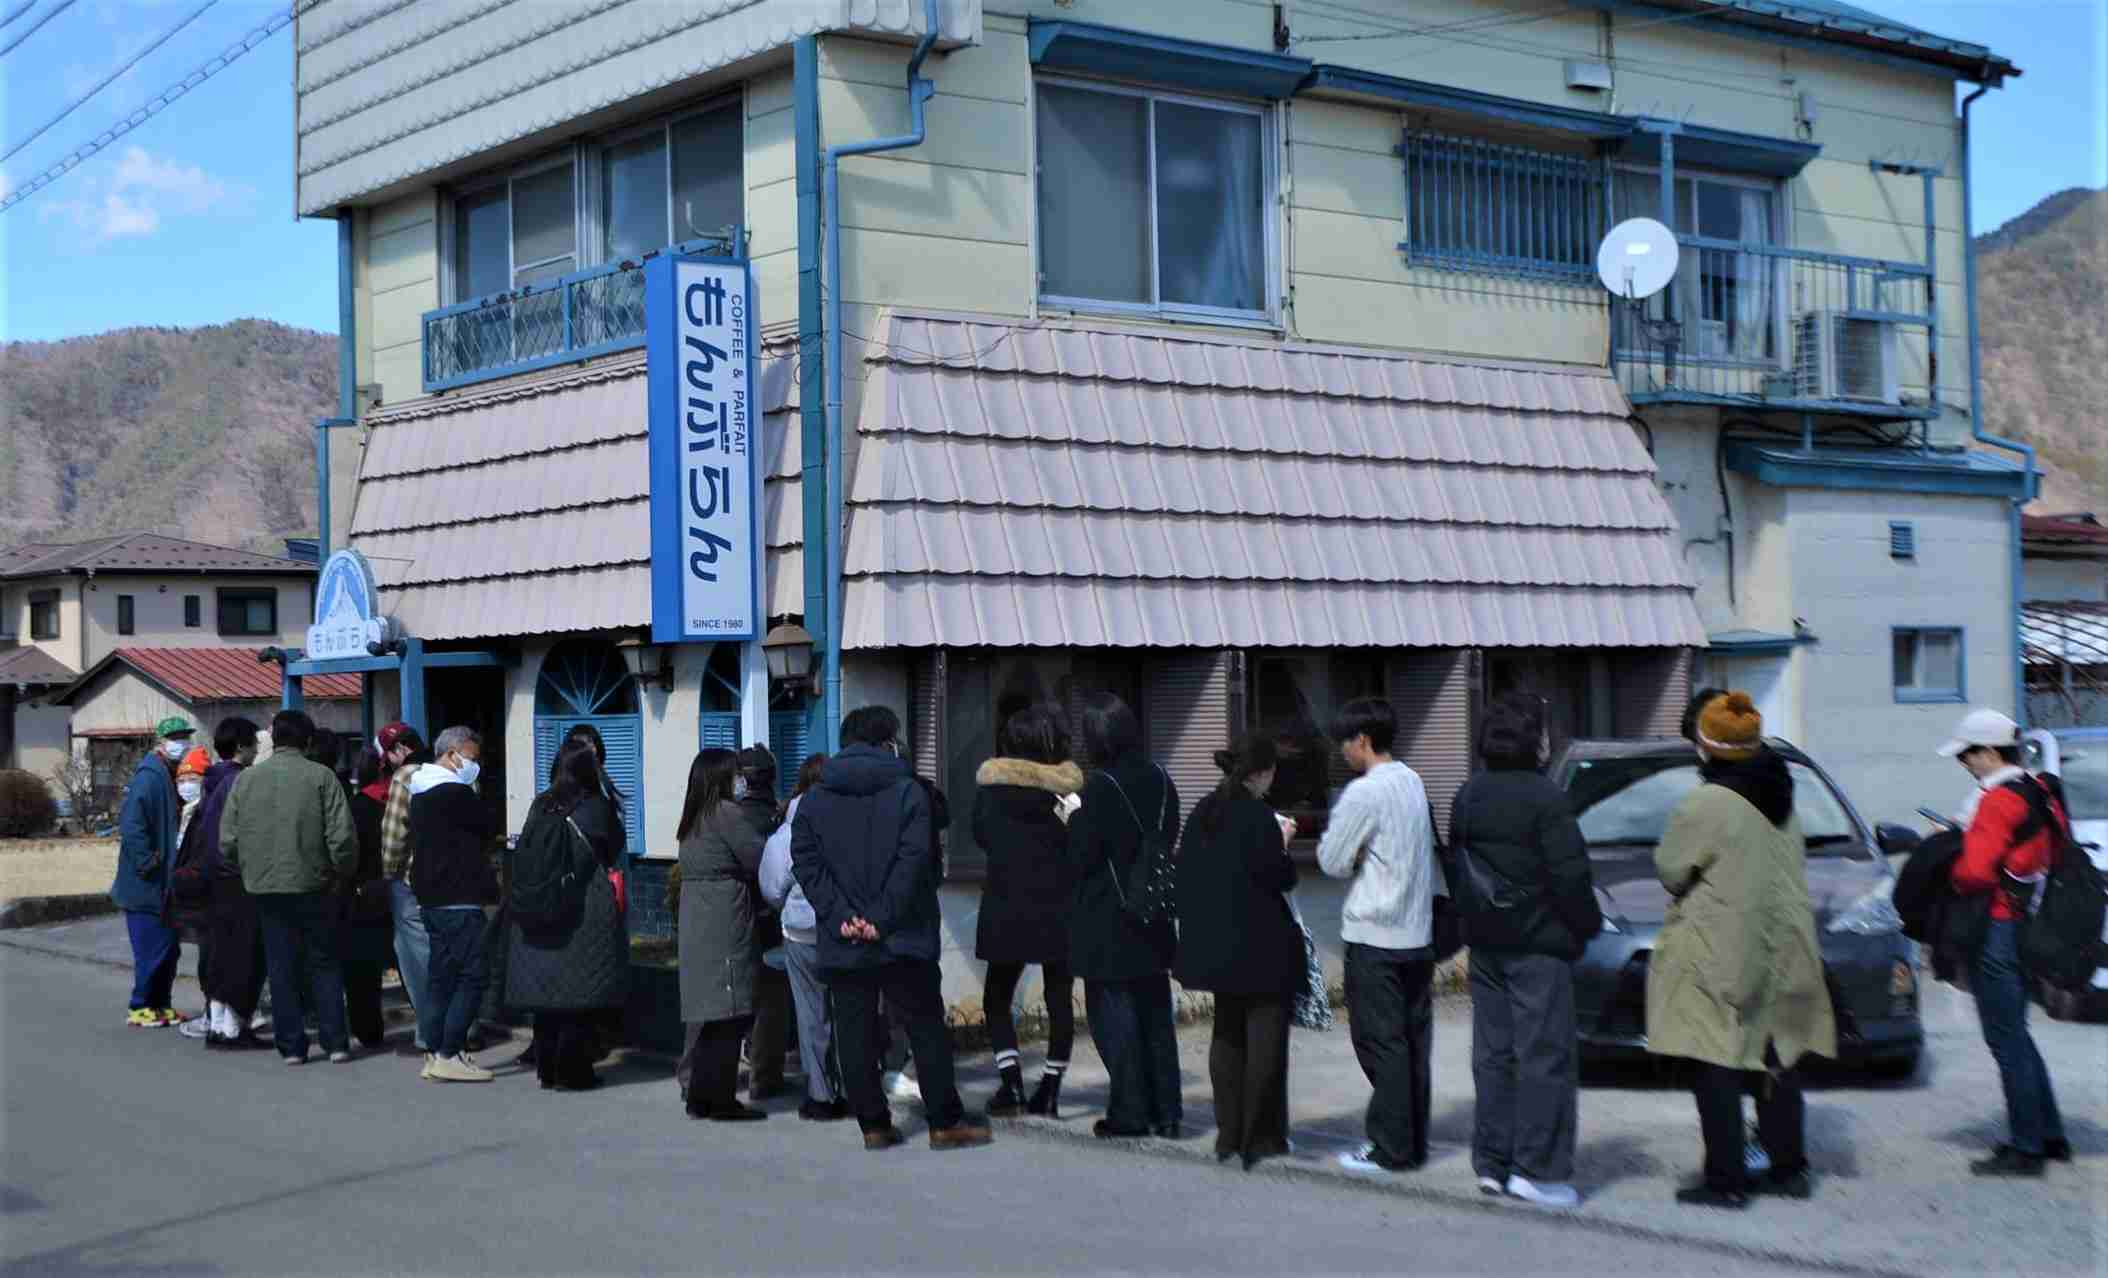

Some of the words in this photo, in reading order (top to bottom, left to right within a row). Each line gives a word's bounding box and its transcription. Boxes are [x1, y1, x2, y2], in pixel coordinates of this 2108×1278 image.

[731, 294, 744, 359] COFFEE
[733, 368, 744, 379] &
[685, 276, 732, 583] もんぶらん
[733, 390, 746, 457] PARFAIT
[692, 619, 721, 630] SINCE
